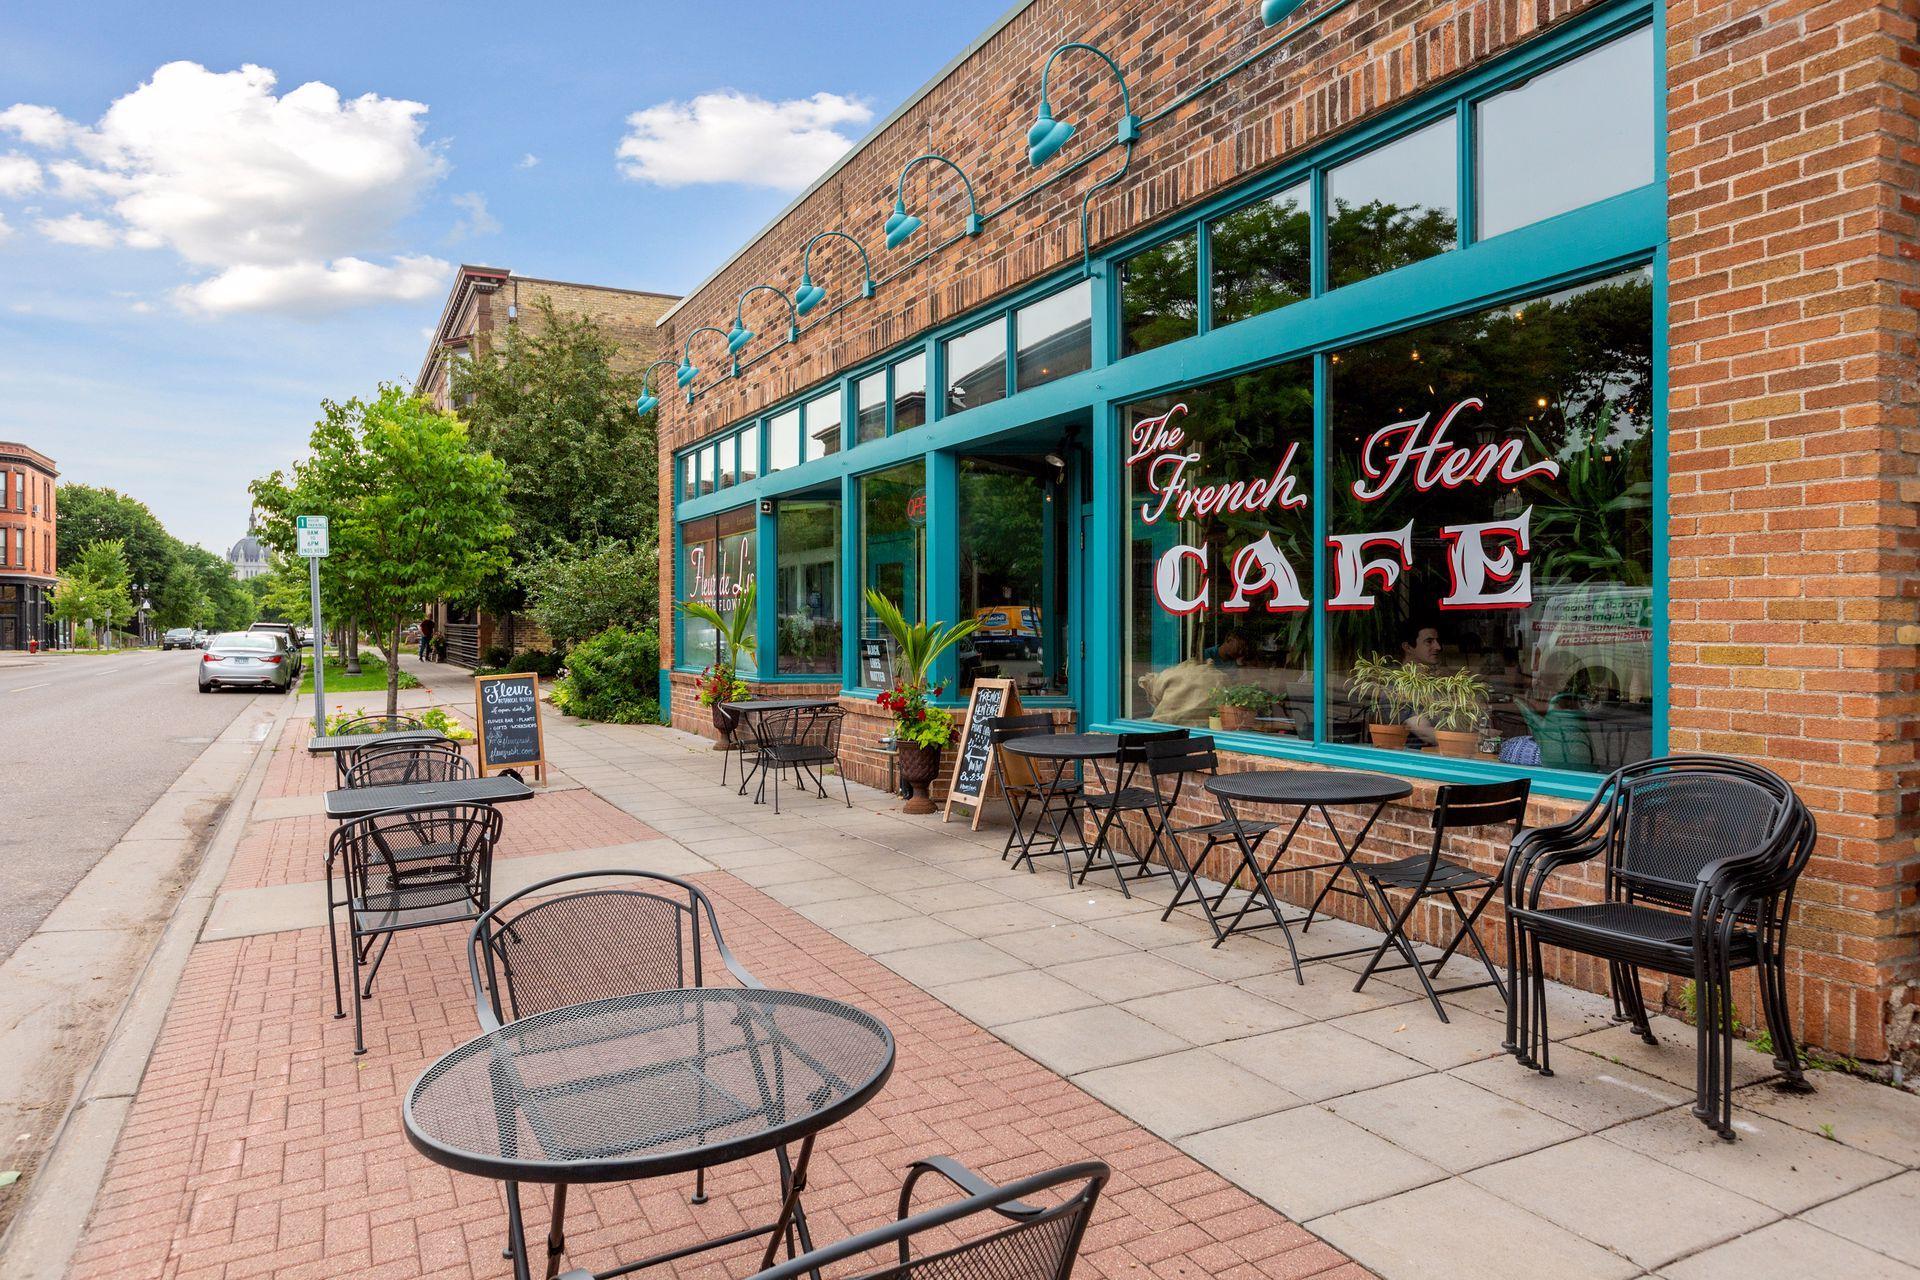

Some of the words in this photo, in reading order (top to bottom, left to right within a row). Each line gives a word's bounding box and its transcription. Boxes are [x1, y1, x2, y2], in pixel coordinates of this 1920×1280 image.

[1126, 403, 1188, 466] The
[1142, 441, 1308, 525] French
[1351, 397, 1560, 502] Hen
[907, 495, 927, 517] OPE
[689, 547, 717, 598] Fleur
[719, 551, 730, 596] de
[1153, 503, 1533, 617] CAFE
[485, 681, 532, 703] Fleur
